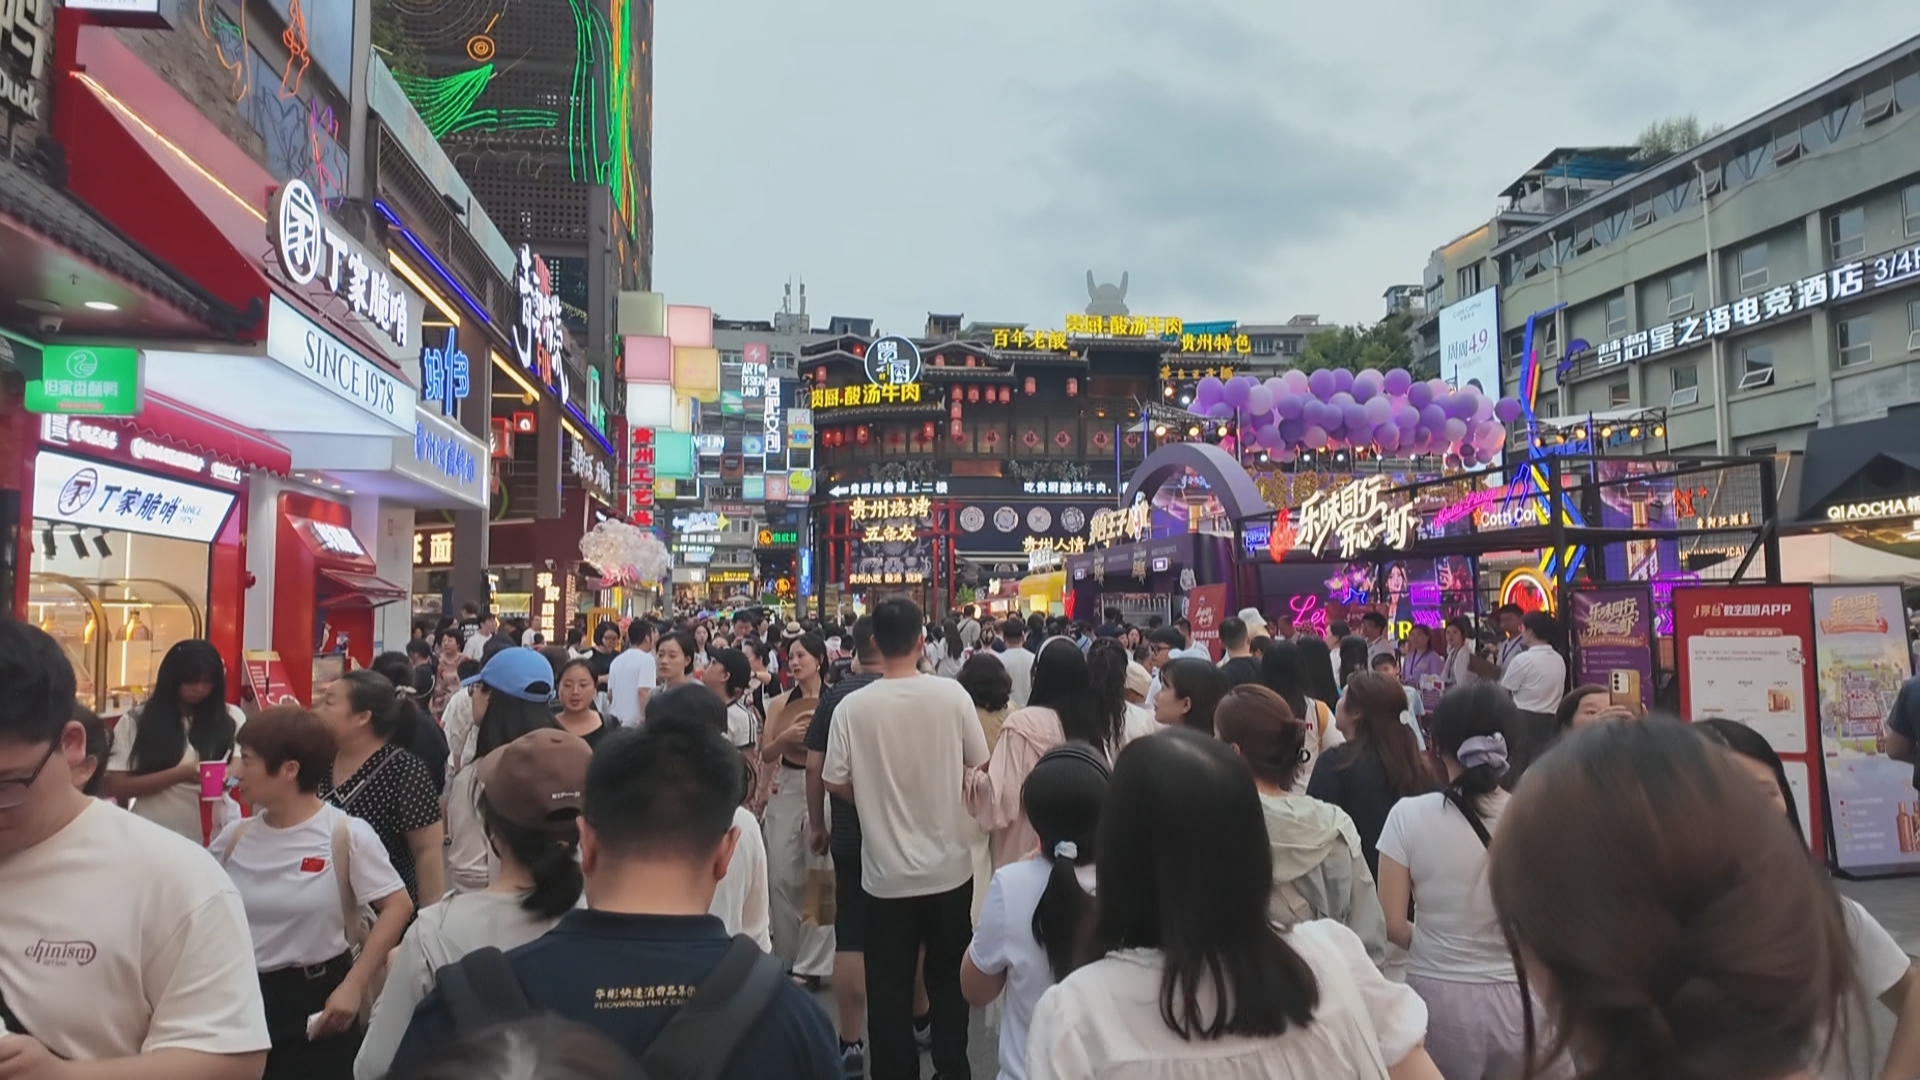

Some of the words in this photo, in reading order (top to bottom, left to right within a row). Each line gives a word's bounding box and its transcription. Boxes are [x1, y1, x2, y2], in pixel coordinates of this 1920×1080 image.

[324, 227, 408, 347] 丁家脆哨
[1180, 333, 1252, 354] 贵州特色
[304, 330, 360, 397] SINCE
[365, 371, 396, 415] 1978
[99, 484, 180, 524] 丁家脆哨
[849, 495, 931, 520] 贵州烧烤
[1827, 498, 1906, 521] QIAOCHA
[1481, 509, 1512, 526] Cotti
